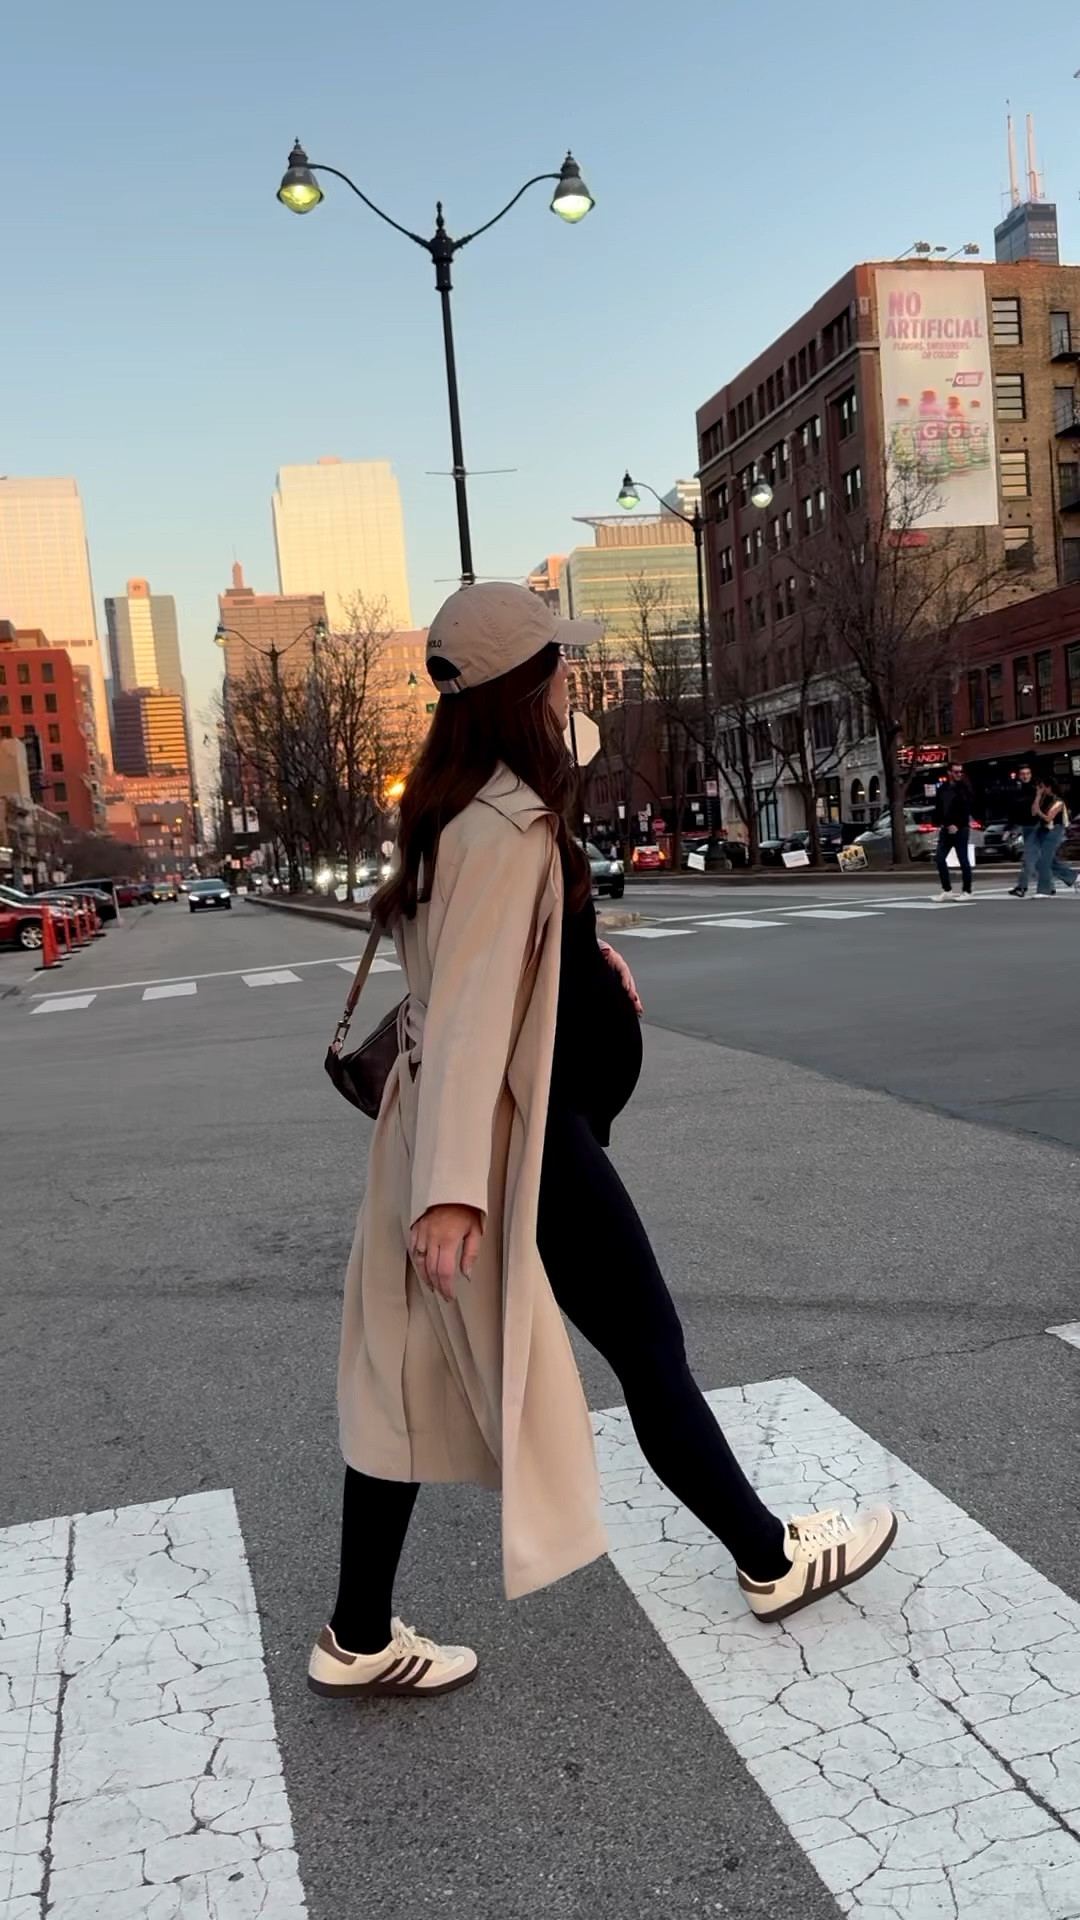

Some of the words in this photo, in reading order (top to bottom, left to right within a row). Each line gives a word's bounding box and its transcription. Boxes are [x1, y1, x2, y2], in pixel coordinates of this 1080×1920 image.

[888, 291, 921, 317] NO
[884, 318, 984, 339] ARTIFICIAL
[933, 351, 959, 359] COLORS
[1033, 719, 1071, 743] BILLY
